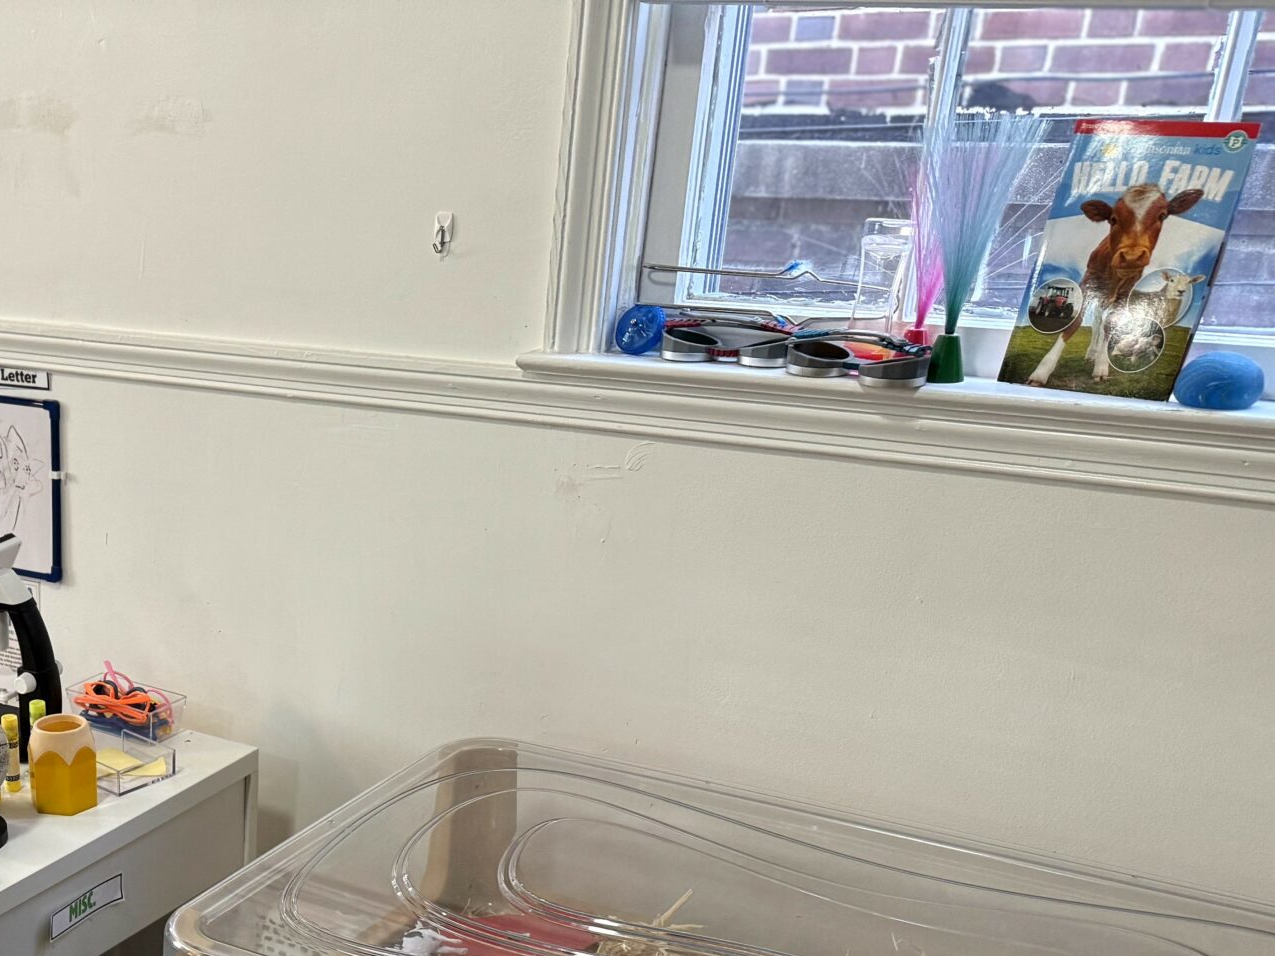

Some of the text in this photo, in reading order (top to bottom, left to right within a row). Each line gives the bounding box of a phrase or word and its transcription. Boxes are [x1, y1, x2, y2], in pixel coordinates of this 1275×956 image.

[1193, 143, 1224, 156] kids
[1070, 160, 1236, 203] HELLO FARM
[0, 368, 37, 384] Letter
[68, 891, 96, 922] MISC.
